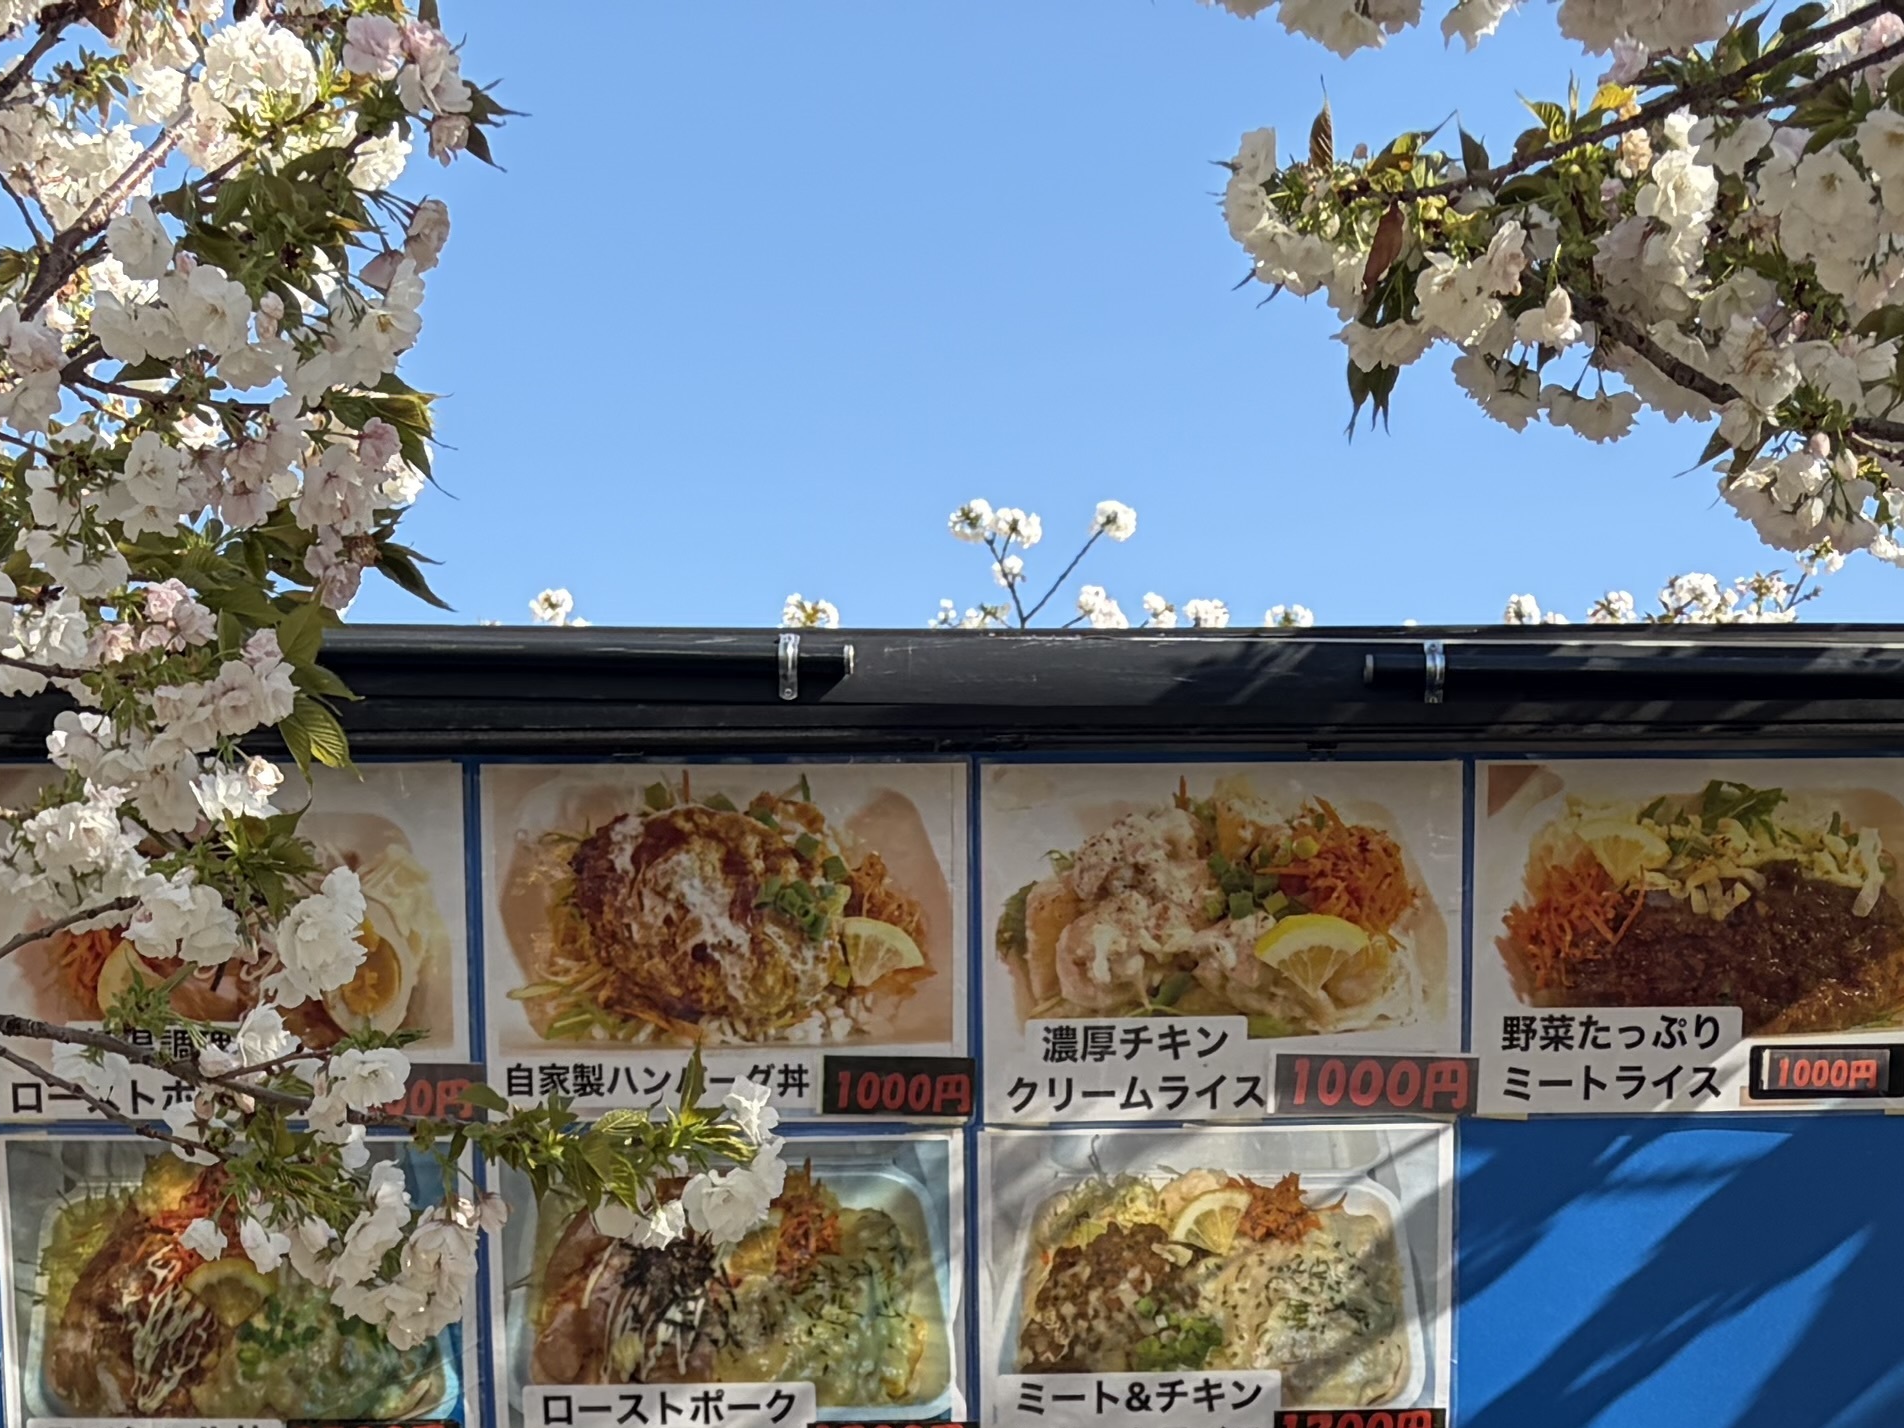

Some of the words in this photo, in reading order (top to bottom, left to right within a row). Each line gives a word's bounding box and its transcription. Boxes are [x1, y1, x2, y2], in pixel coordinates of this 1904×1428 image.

[1042, 1026, 1229, 1062] 濃厚チキン
[1501, 1013, 1722, 1054] 野菜たっぷり
[836, 1070, 971, 1113] 1000円
[1289, 1058, 1471, 1111] 1000円
[1502, 1063, 1723, 1103] ミートライス
[1772, 1053, 1877, 1090] 1000円
[1007, 1074, 1267, 1116] クリームライス
[541, 1390, 799, 1427] ローストポーク
[1016, 1380, 1265, 1415] ミート&チキン
